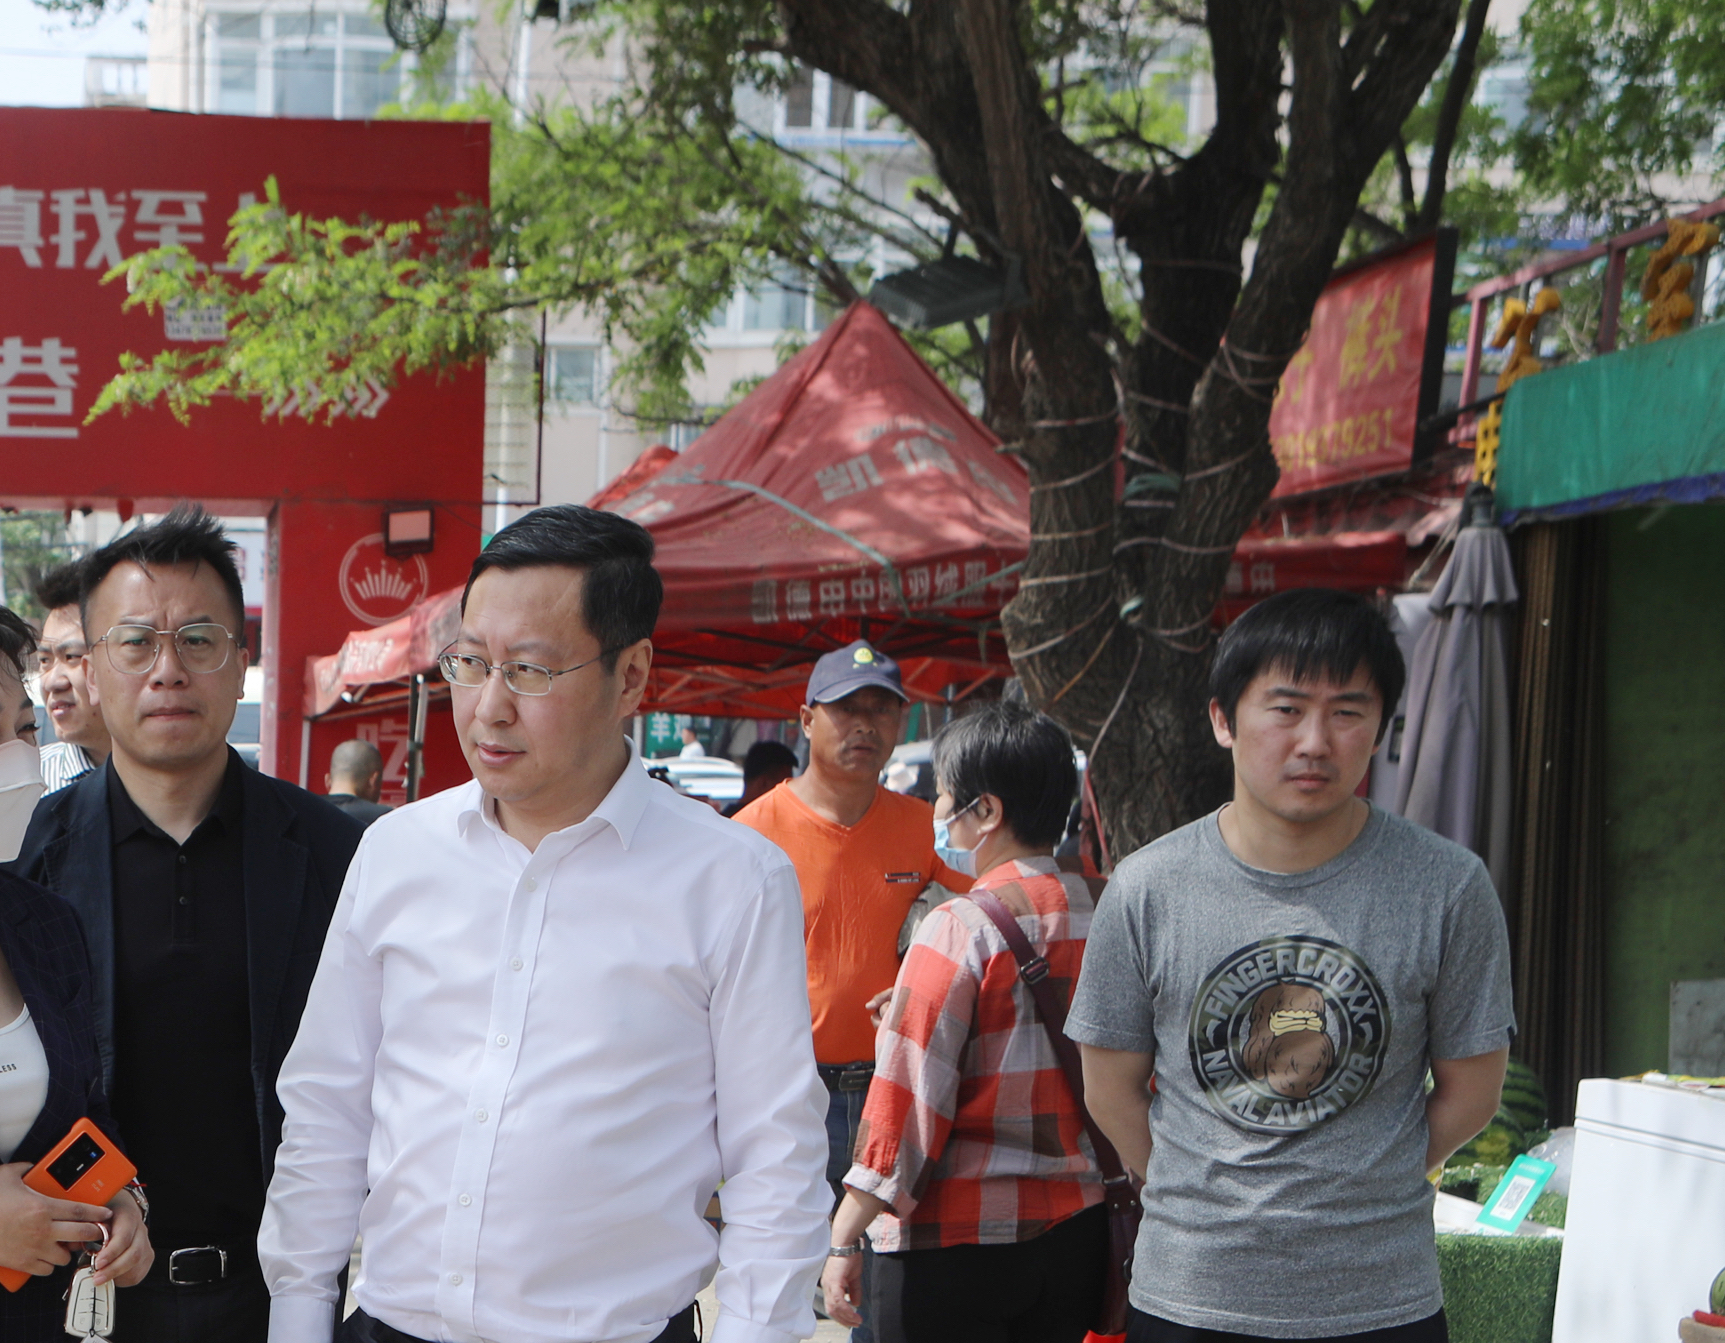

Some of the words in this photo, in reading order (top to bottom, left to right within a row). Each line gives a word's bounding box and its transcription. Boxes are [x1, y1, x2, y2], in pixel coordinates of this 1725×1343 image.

[1205, 948, 1377, 1024] FINGERCROXX
[1203, 1049, 1260, 1122] NAVAL
[1263, 1052, 1373, 1126] AVIATOR
